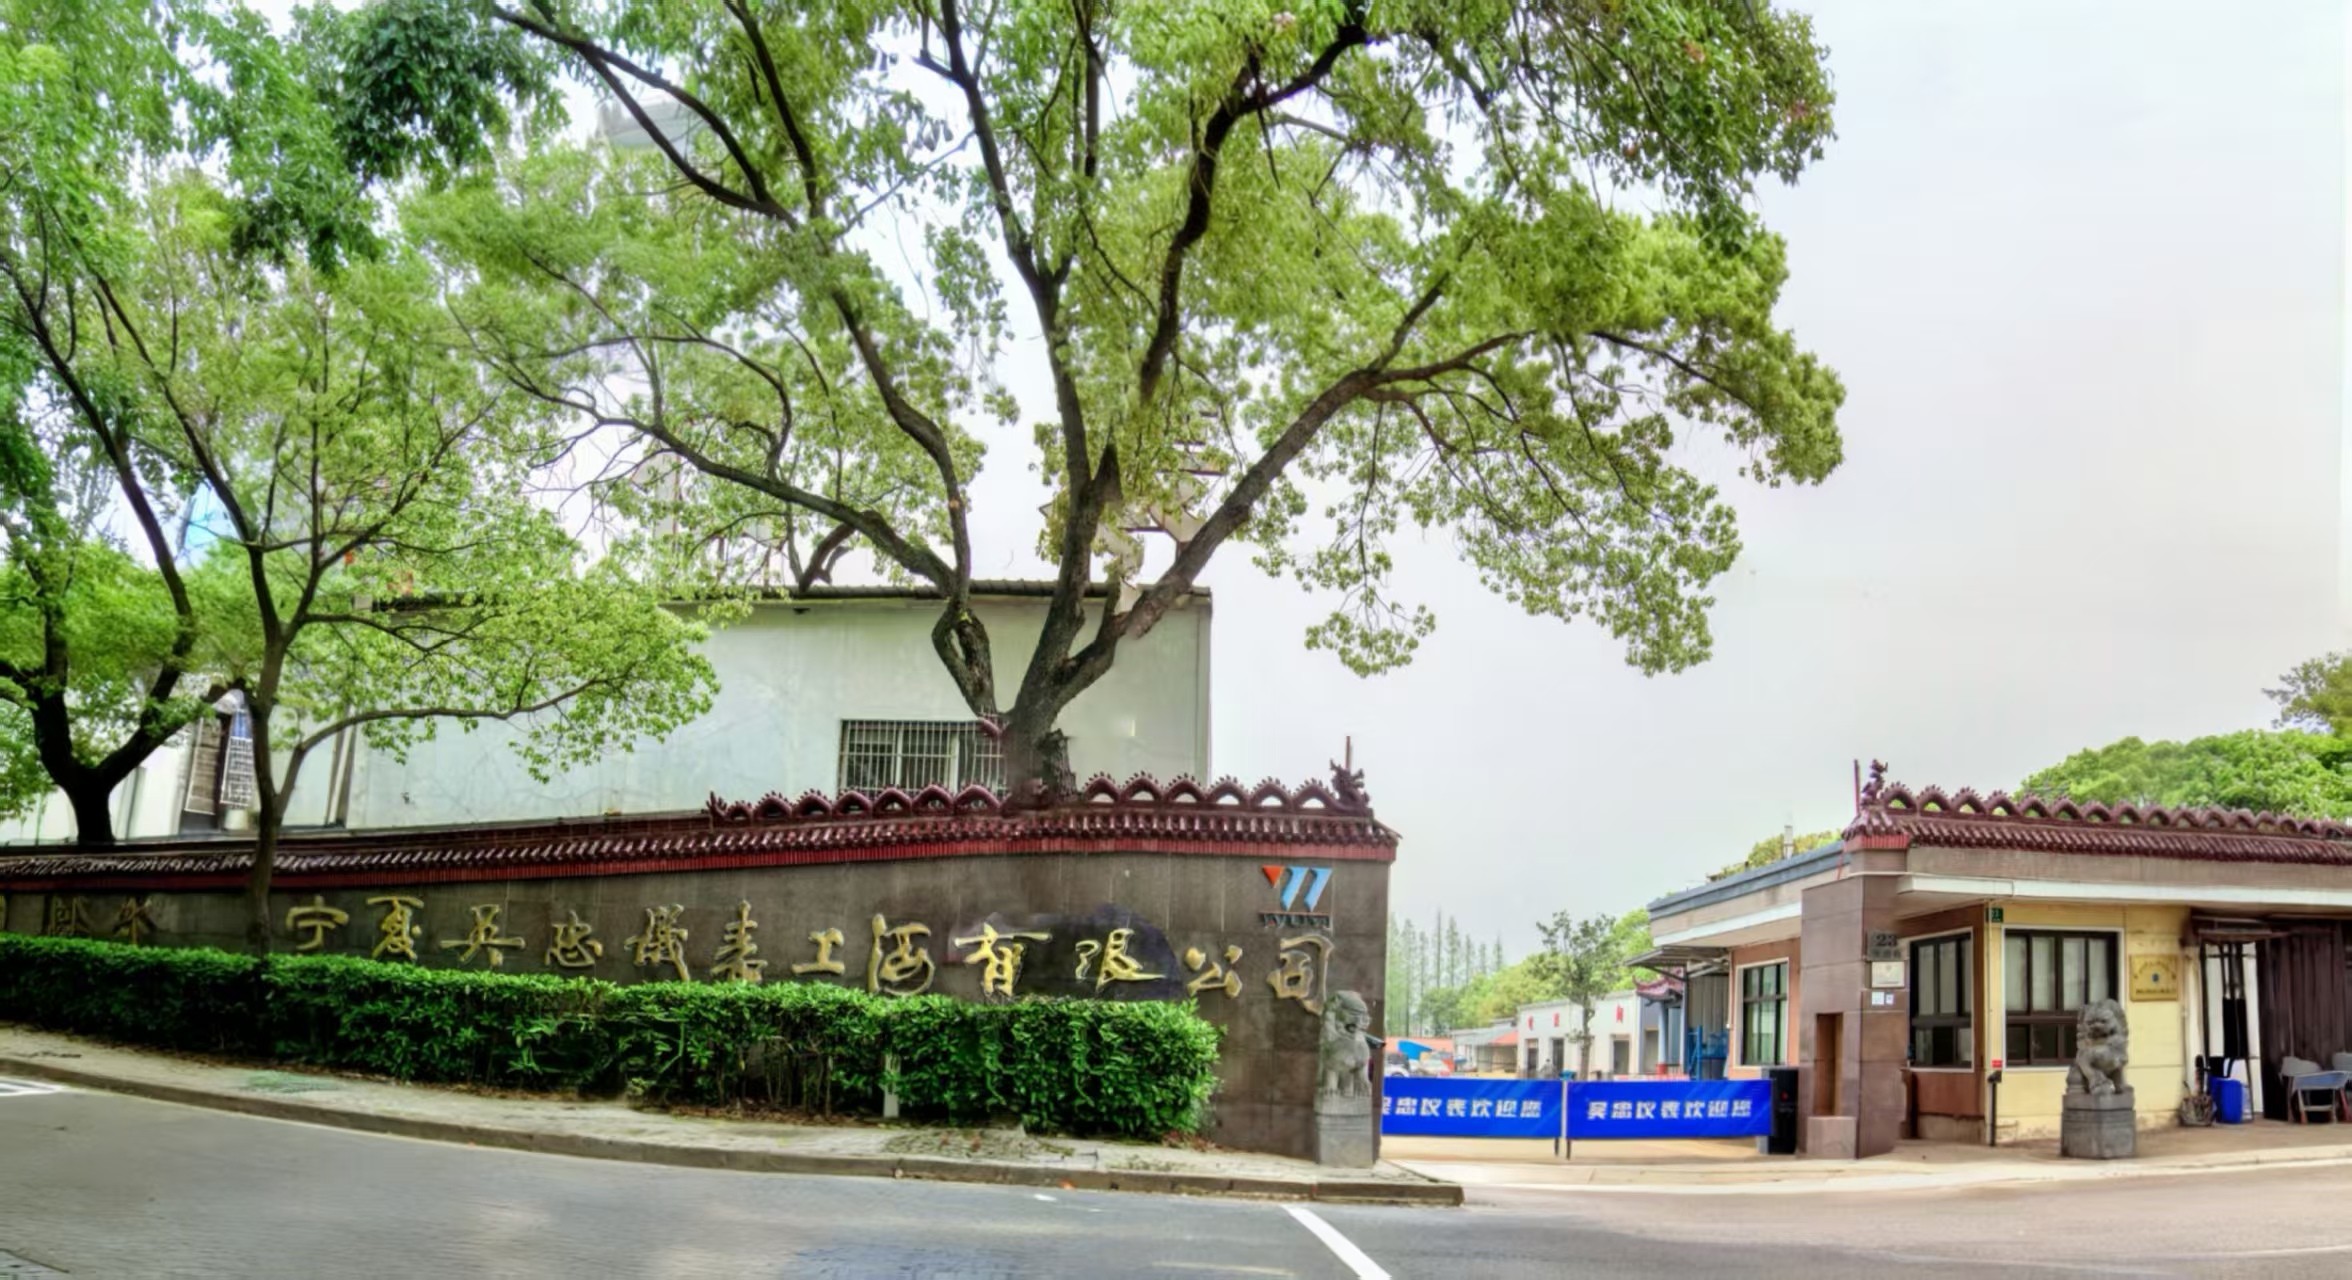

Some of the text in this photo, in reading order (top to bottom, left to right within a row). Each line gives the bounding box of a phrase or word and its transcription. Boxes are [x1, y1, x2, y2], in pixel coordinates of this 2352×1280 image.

[1587, 1099, 1752, 1120] 吴忠仪表欢迎您
